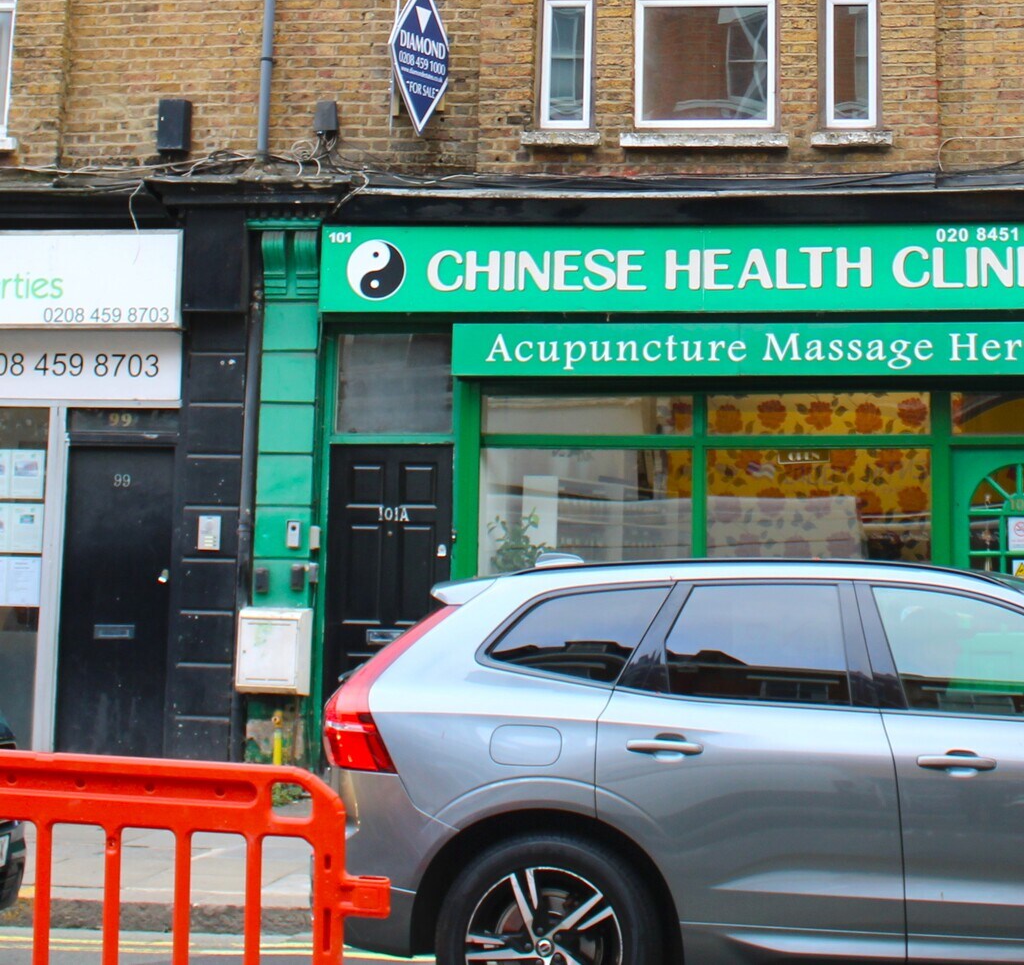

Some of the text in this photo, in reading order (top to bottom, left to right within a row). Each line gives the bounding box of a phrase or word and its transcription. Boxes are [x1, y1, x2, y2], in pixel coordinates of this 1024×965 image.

[399, 29, 446, 60] DIAMOND
[398, 50, 415, 66] 0208
[415, 56, 429, 71] 459
[429, 60, 446, 76] 1000
[328, 231, 352, 244] 101
[936, 228, 969, 243] 020
[976, 227, 1019, 242] 8451
[426, 249, 648, 292] CHINESE
[664, 245, 873, 291] HEALTH
[43, 307, 170, 323] 0208 459 8703
[484, 332, 748, 370] Acupuncture
[762, 332, 934, 370] Massage
[34, 352, 84, 377] 459
[93, 353, 160, 378] 8703
[109, 413, 133, 428] 99
[113, 473, 131, 488] 99
[378, 506, 410, 522] 101A
